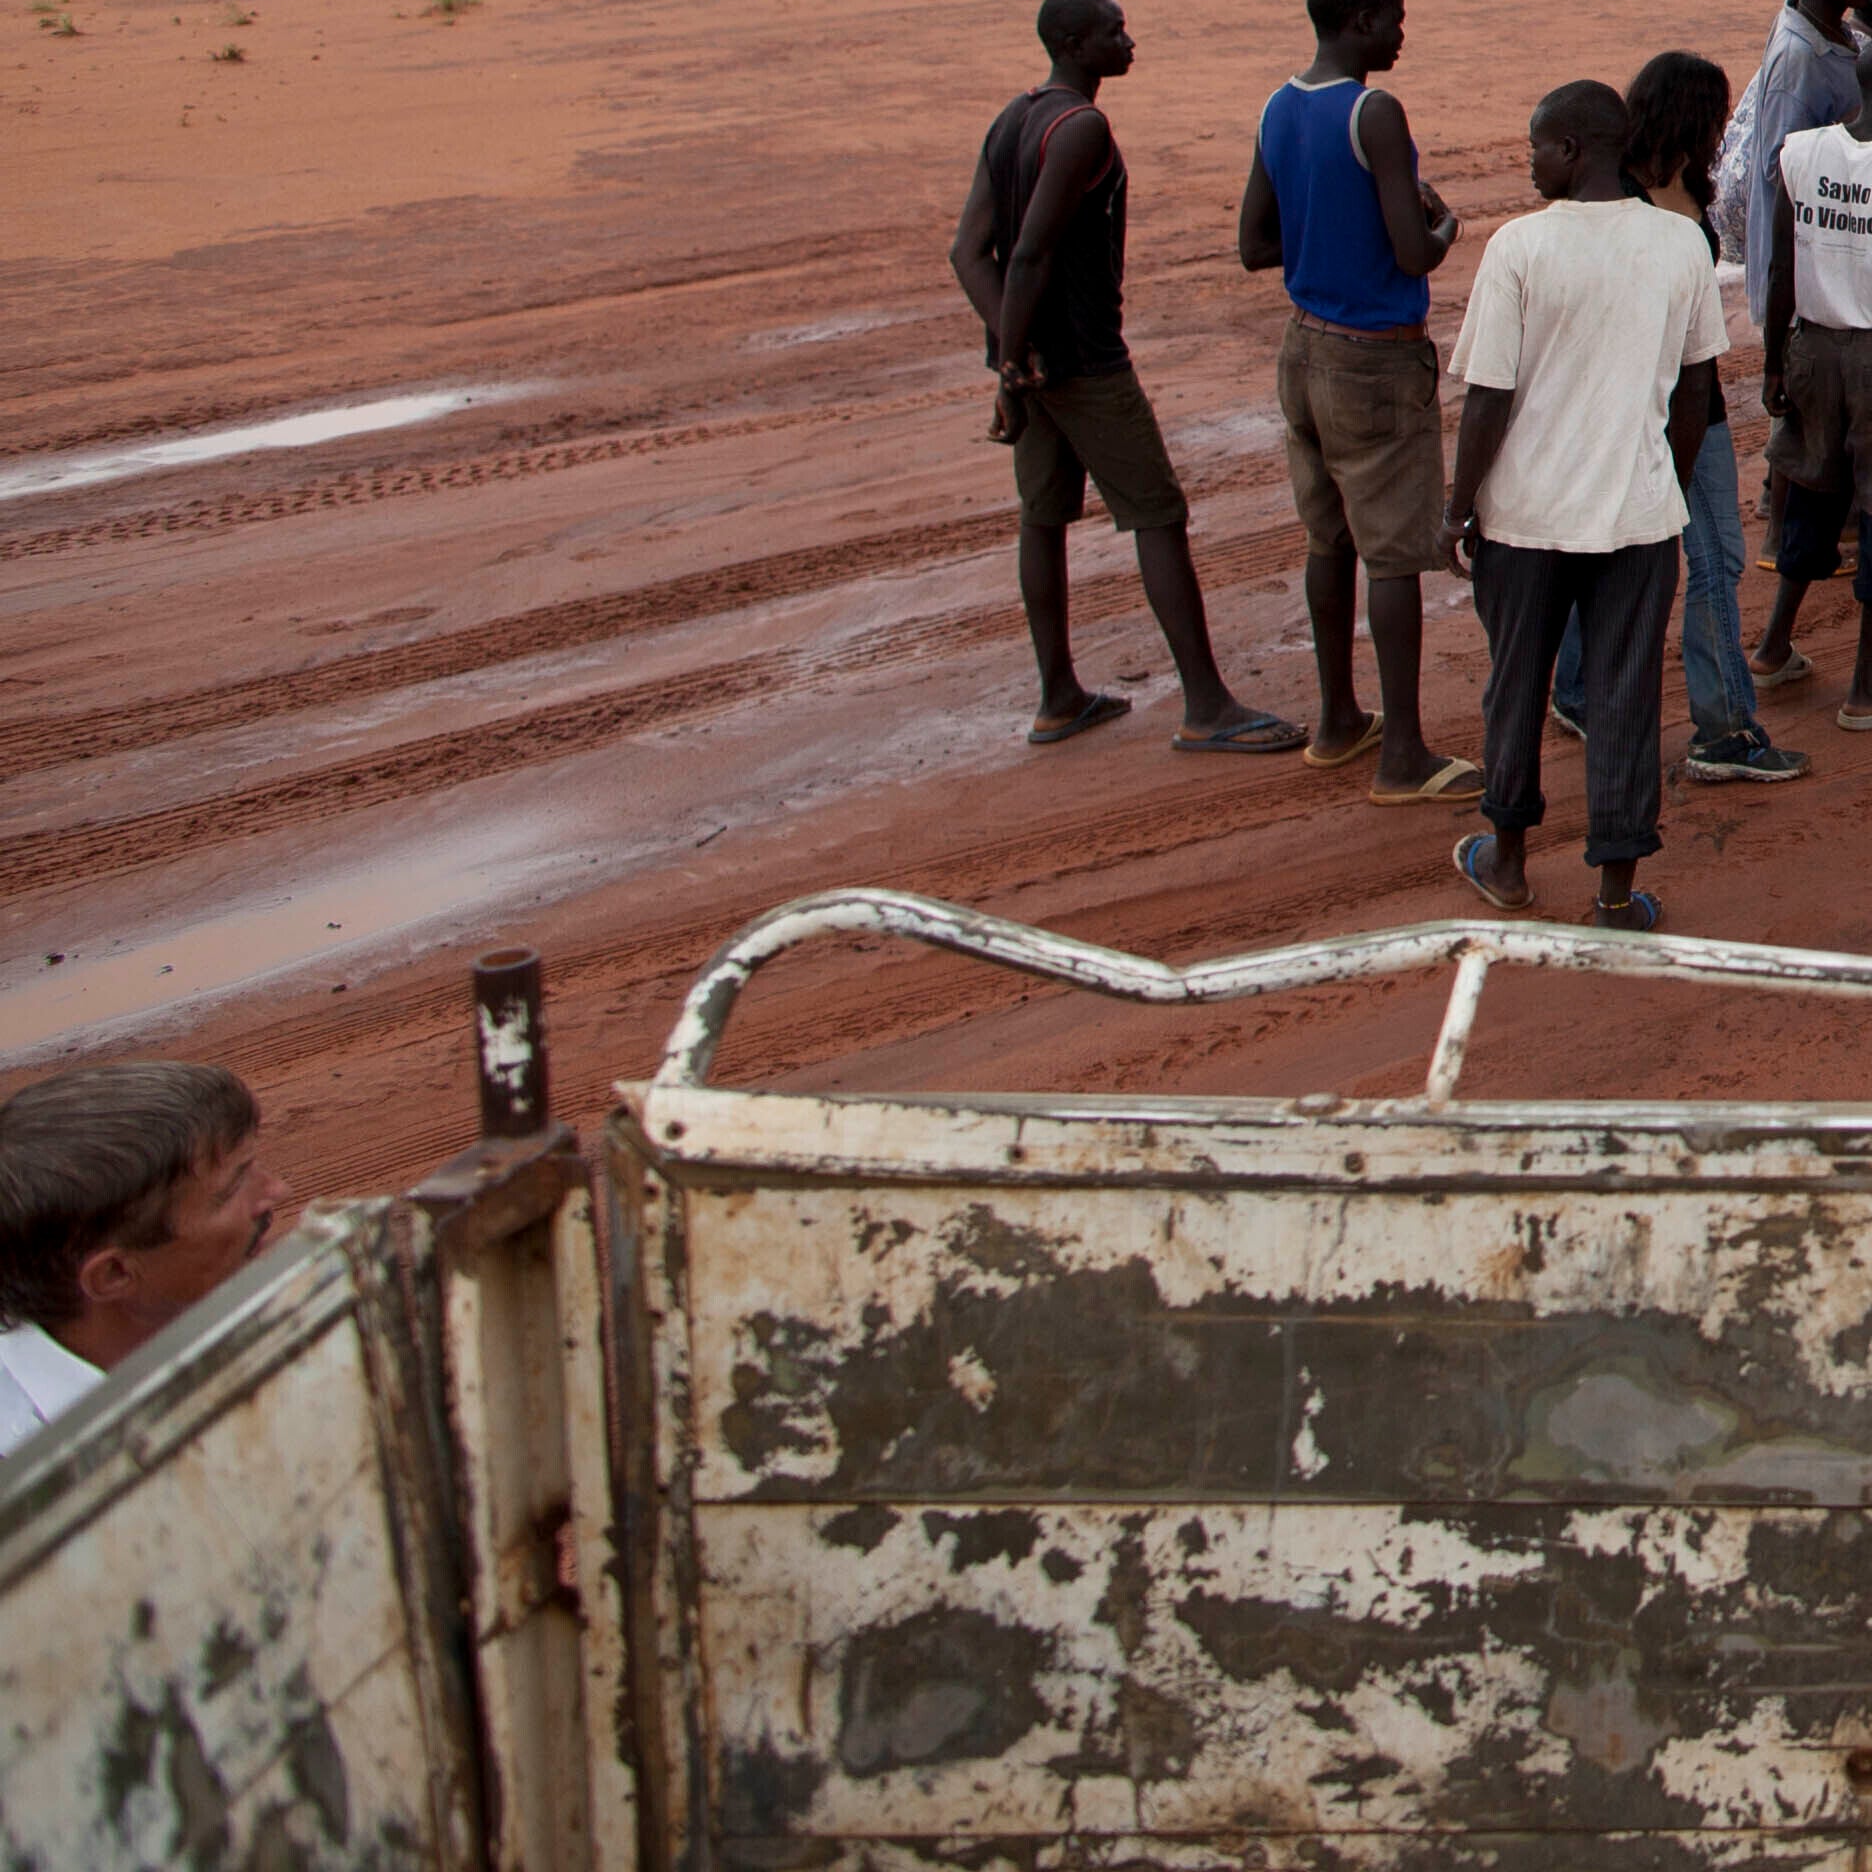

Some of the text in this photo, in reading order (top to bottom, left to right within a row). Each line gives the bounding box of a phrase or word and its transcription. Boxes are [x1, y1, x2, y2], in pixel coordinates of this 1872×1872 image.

[1817, 175, 1872, 204] Say No
[1794, 200, 1814, 225] To
